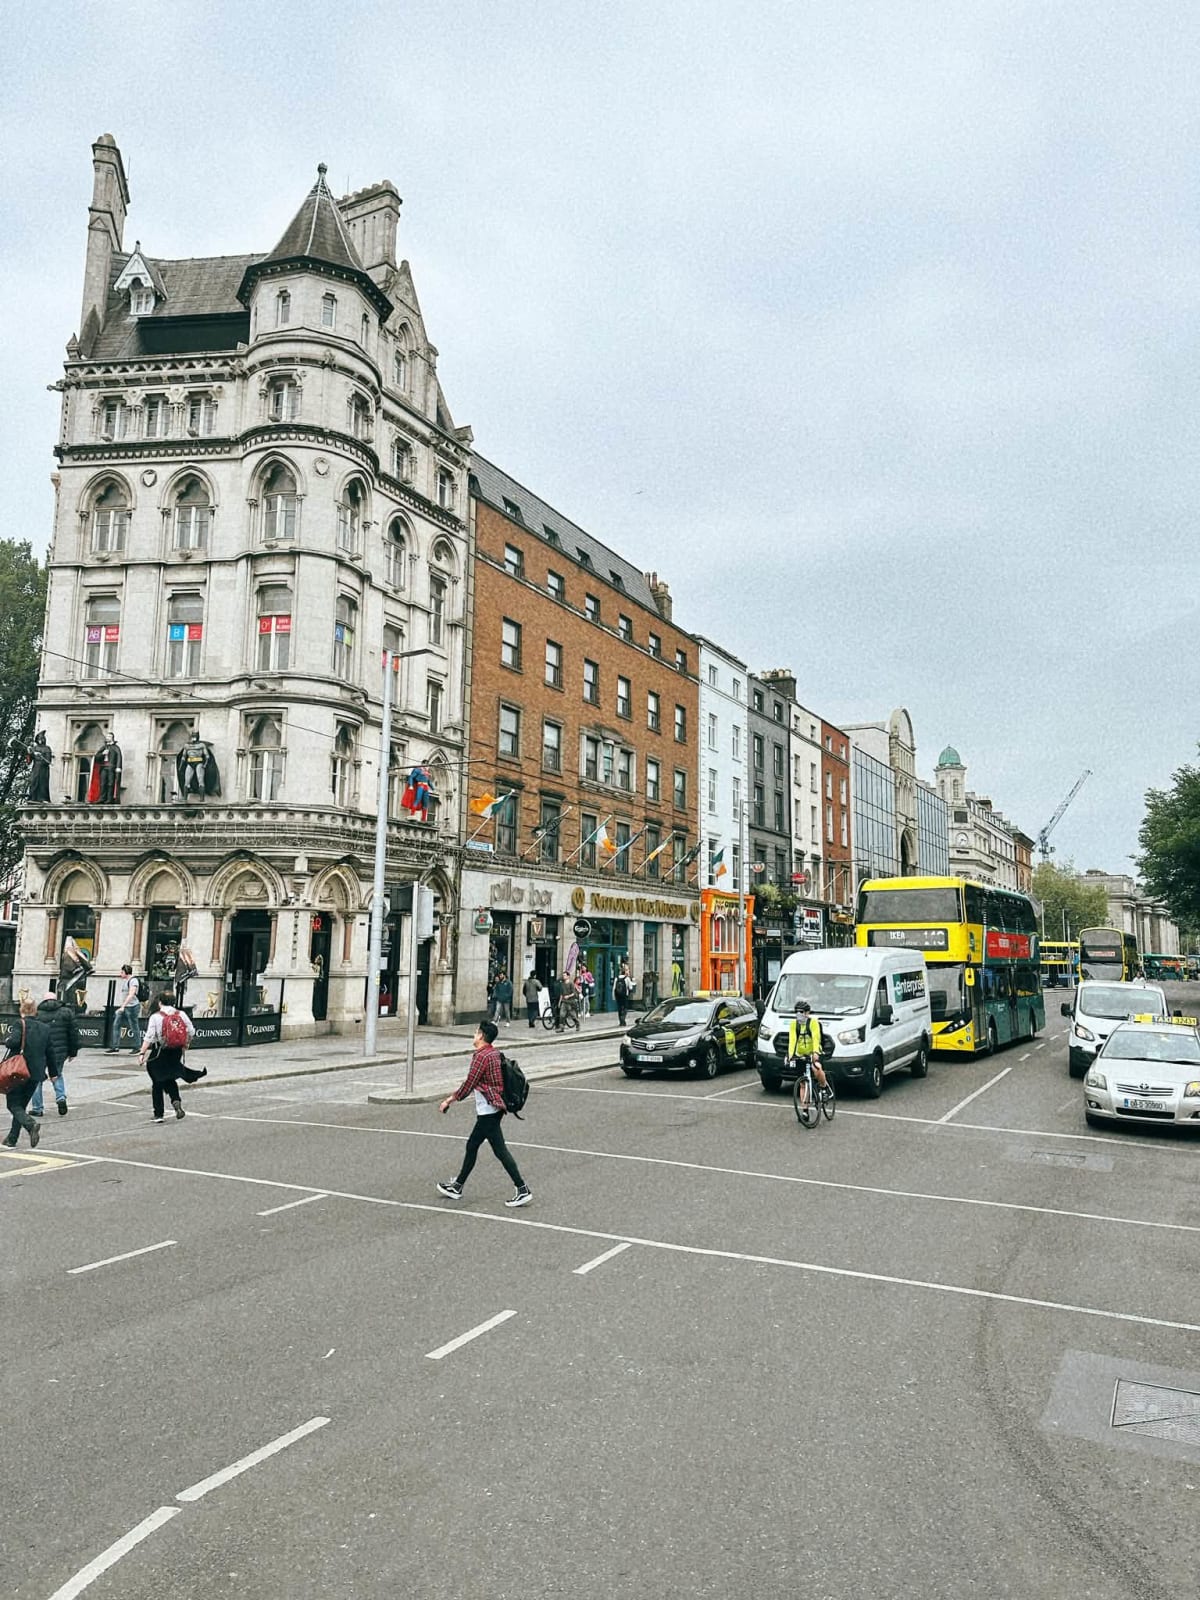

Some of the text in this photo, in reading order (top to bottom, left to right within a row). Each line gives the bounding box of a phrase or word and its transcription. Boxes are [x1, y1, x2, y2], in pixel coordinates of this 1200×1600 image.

[889, 931, 905, 939] IKEA
[196, 1029, 231, 1038] GUINNESS
[252, 1025, 275, 1034] GUINNESS
